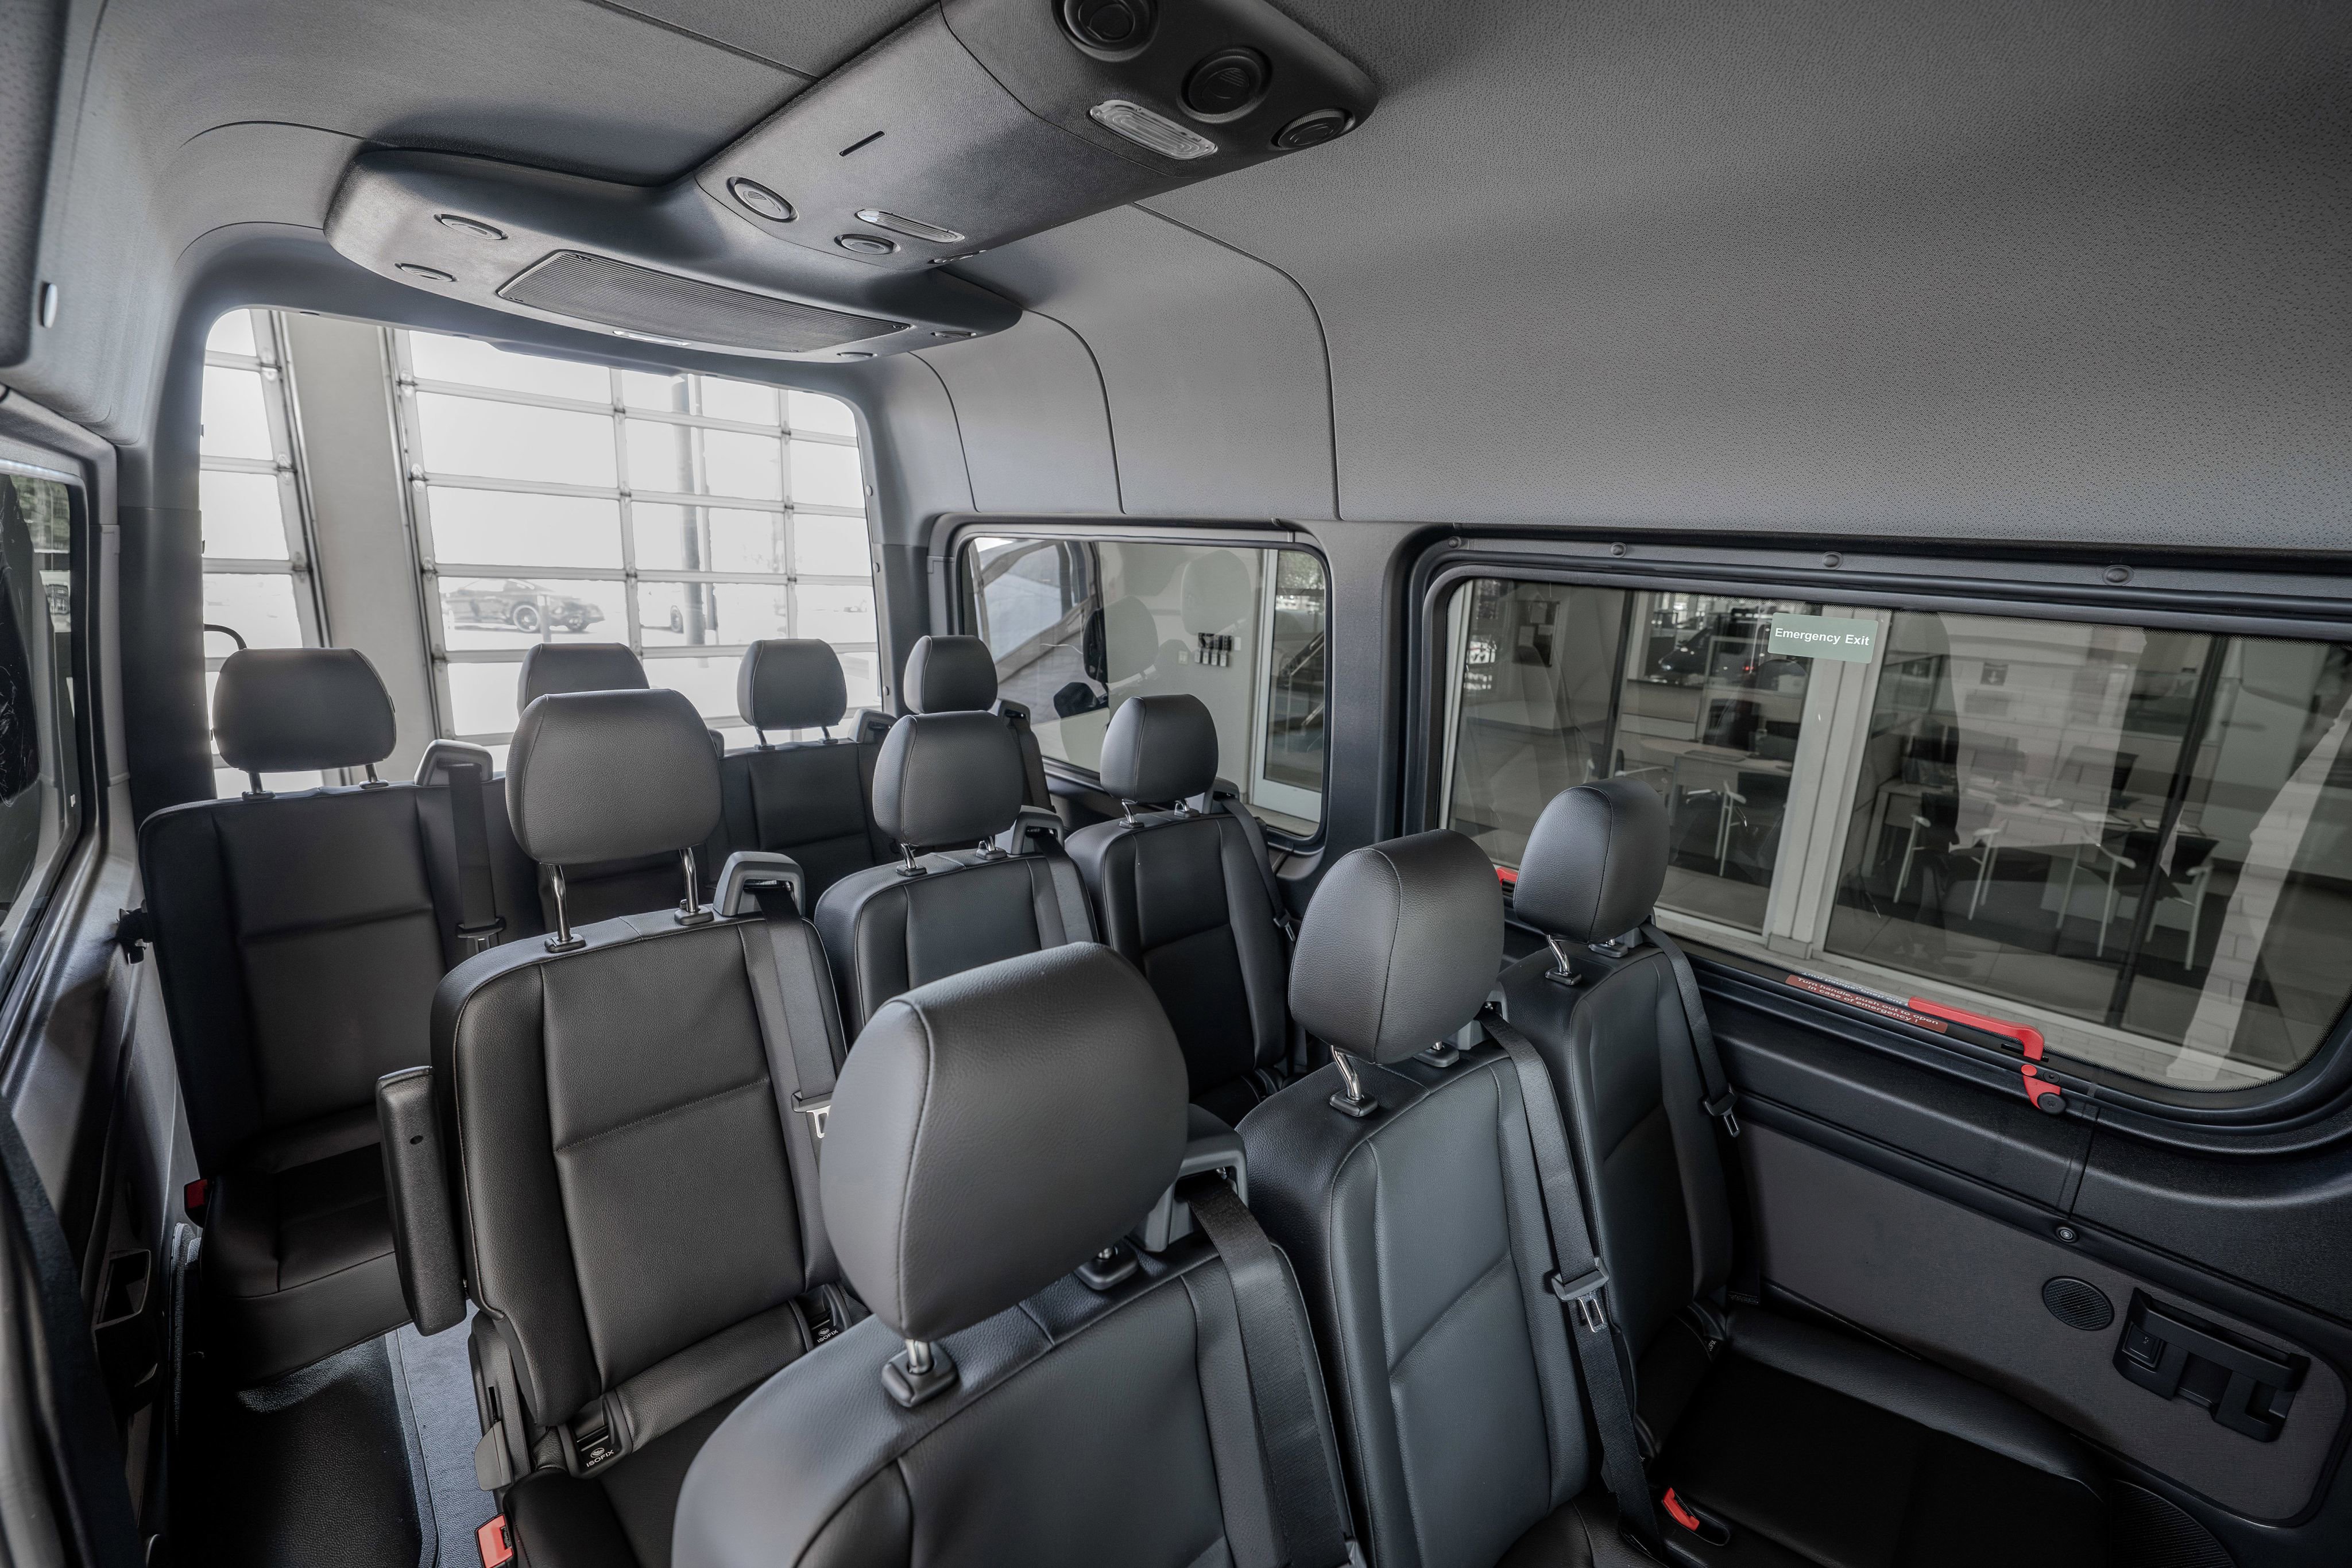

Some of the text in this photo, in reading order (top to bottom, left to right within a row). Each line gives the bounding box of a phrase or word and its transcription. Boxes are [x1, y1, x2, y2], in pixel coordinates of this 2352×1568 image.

[1775, 628, 1870, 646] Emergency Exit
[1797, 977, 1818, 986] Turn
[1820, 985, 1852, 998] handle,
[1855, 996, 1880, 1006] push
[1882, 1004, 1898, 1012] out
[1913, 1014, 1939, 1025] open
[1819, 989, 1842, 999] case
[1855, 1001, 1912, 1021] emergency
[817, 1329, 839, 1343] ISOFIX
[586, 1449, 615, 1468] ISOFIX
